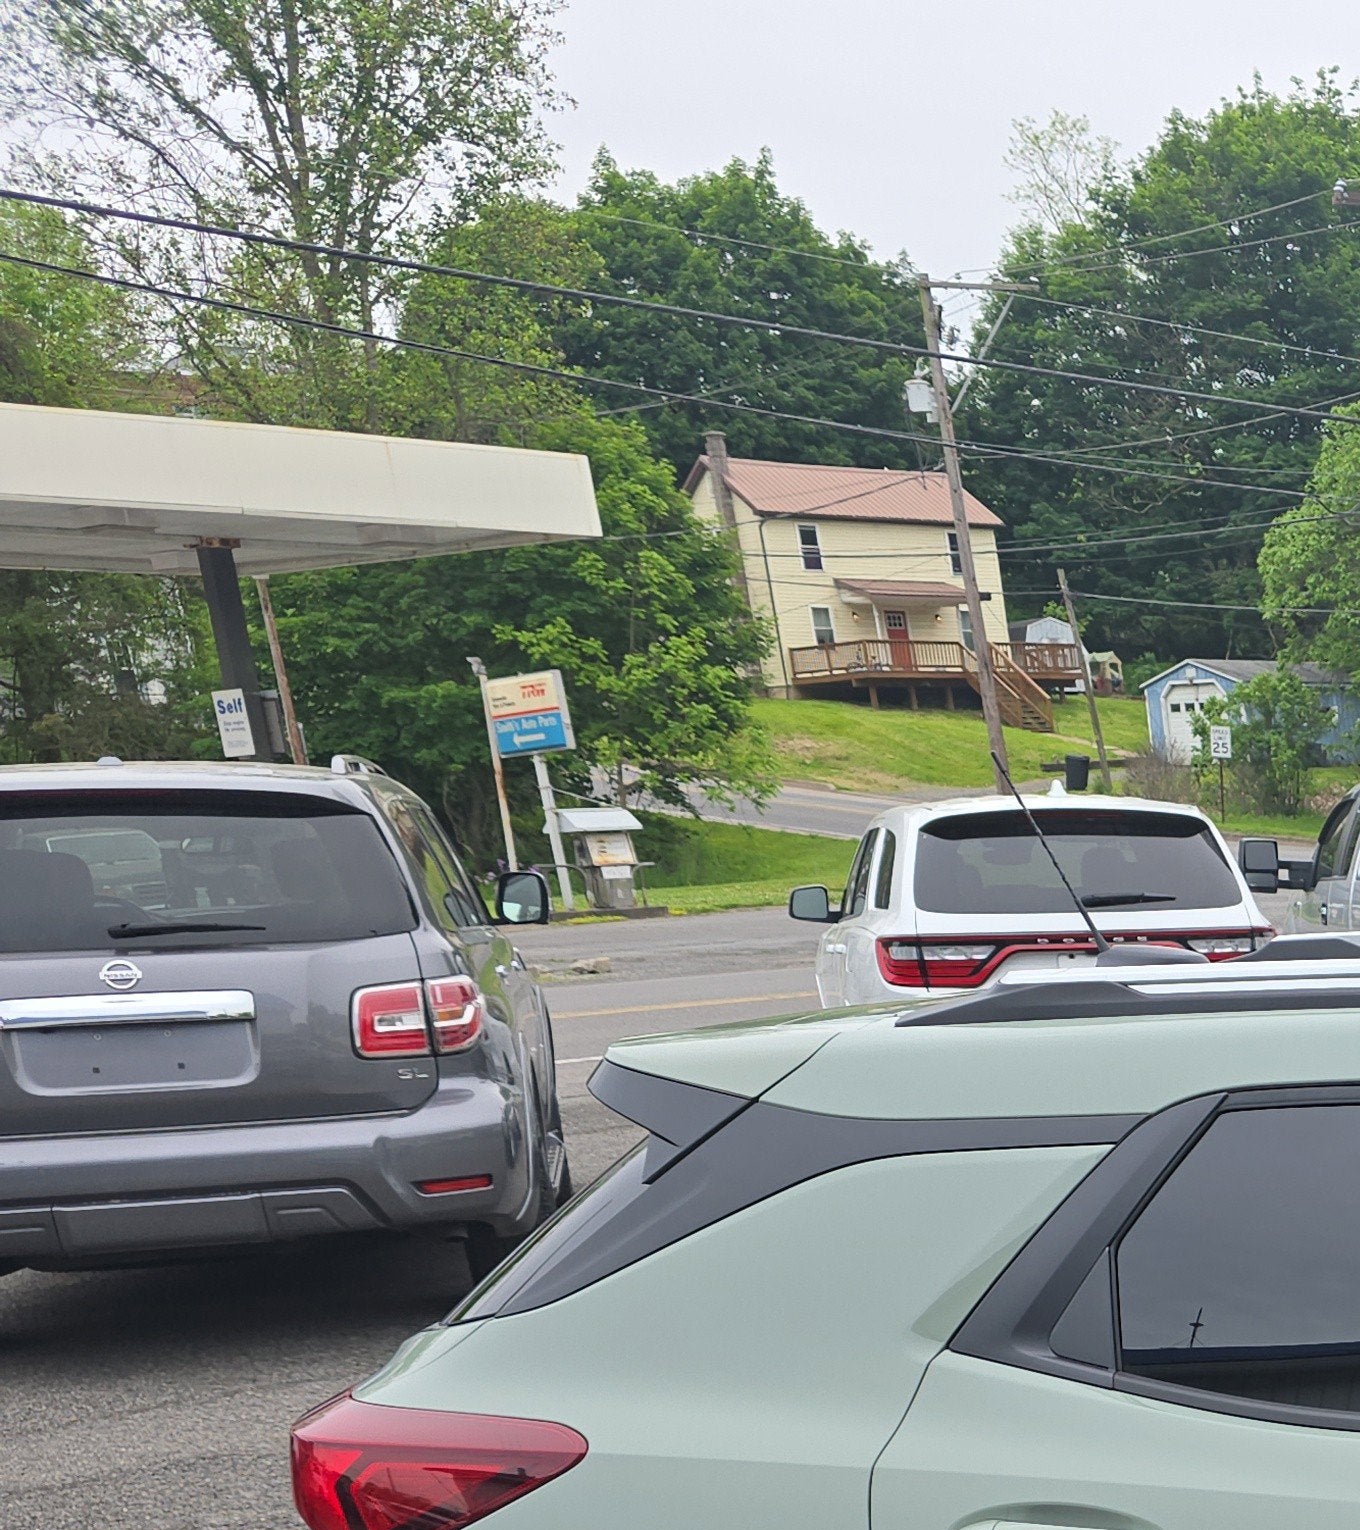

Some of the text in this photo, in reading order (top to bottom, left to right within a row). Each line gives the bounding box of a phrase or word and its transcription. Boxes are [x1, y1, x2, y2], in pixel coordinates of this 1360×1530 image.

[216, 697, 243, 715] Self
[1212, 742, 1229, 754] 25
[397, 1068, 430, 1079] SL
